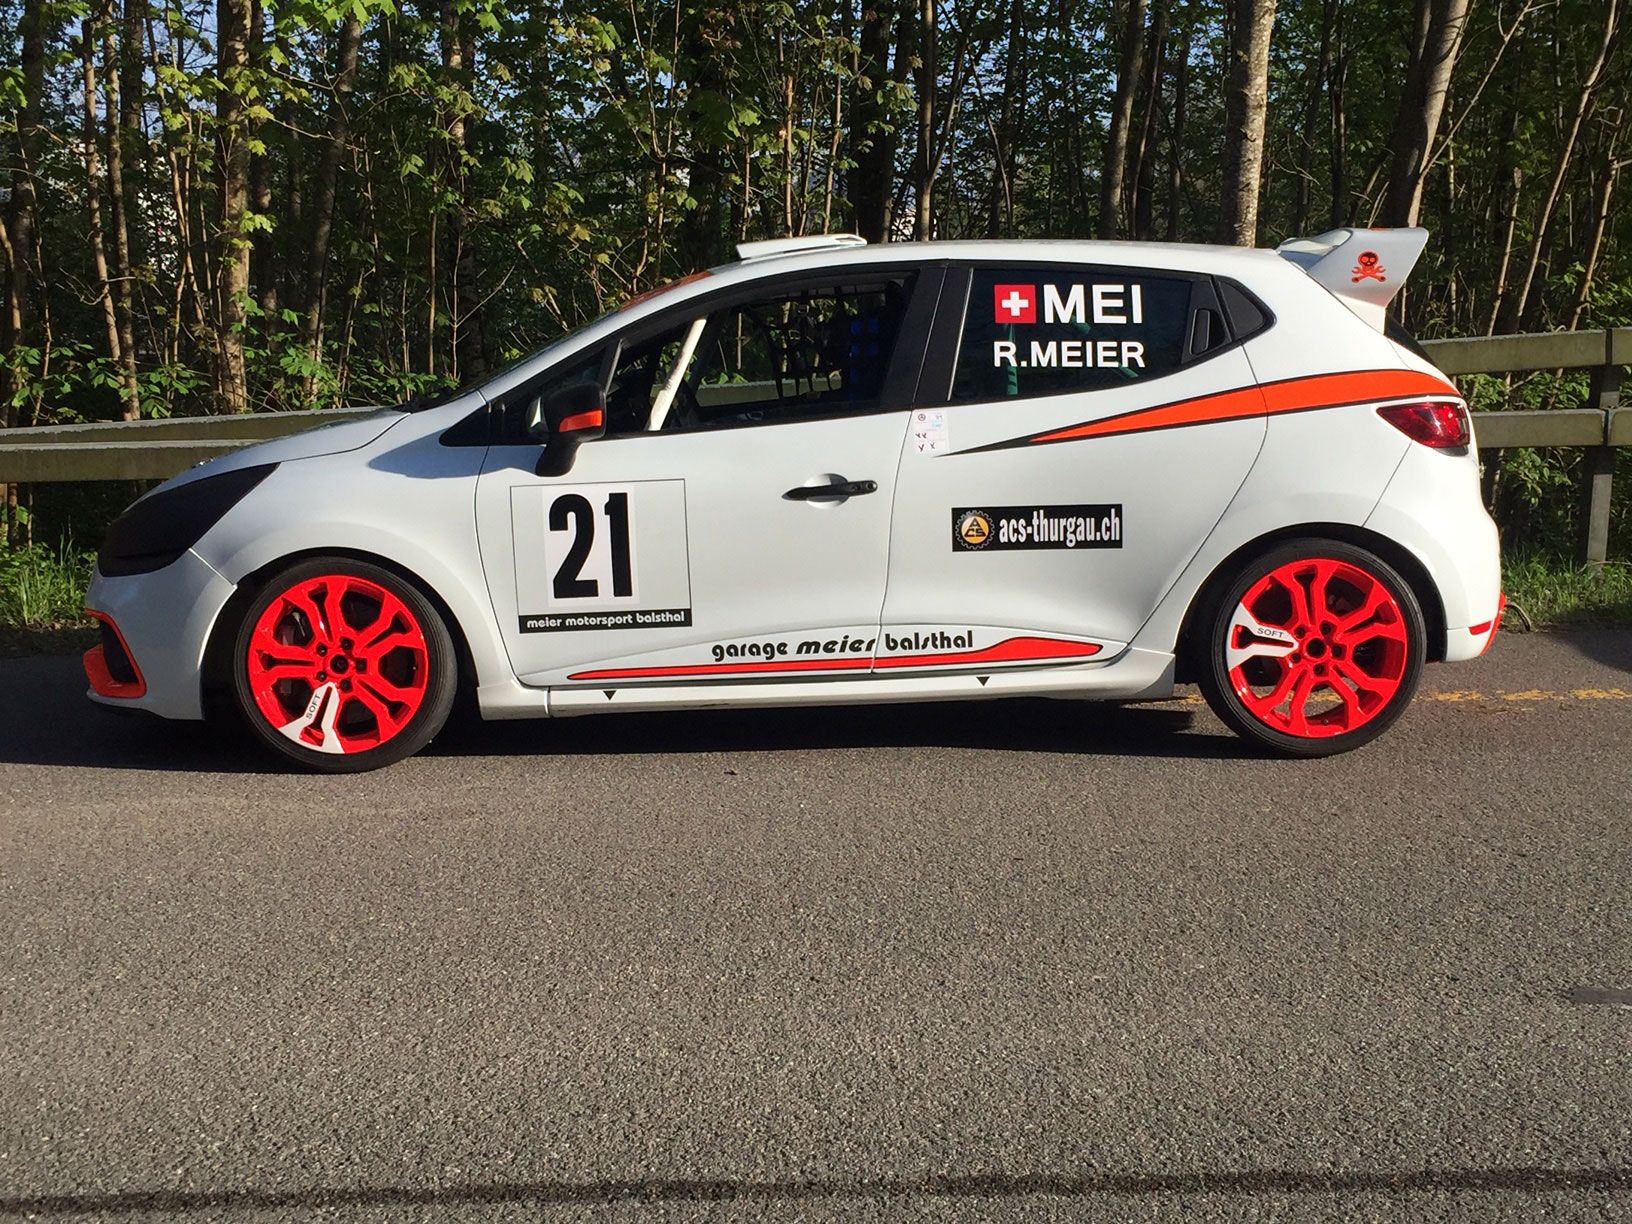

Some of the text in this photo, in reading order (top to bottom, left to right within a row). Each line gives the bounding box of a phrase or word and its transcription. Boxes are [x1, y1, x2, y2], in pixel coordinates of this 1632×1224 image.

[1043, 284, 1143, 324] MEI
[993, 341, 1146, 368] R.MEIER
[999, 508, 1120, 548] acs-thurgau.ch
[549, 492, 633, 599] 21
[526, 611, 685, 629] meier motorsport balsthal
[1257, 627, 1284, 638] SOFT
[711, 630, 973, 662] garage meier balsthal
[305, 693, 321, 720] SOFT
